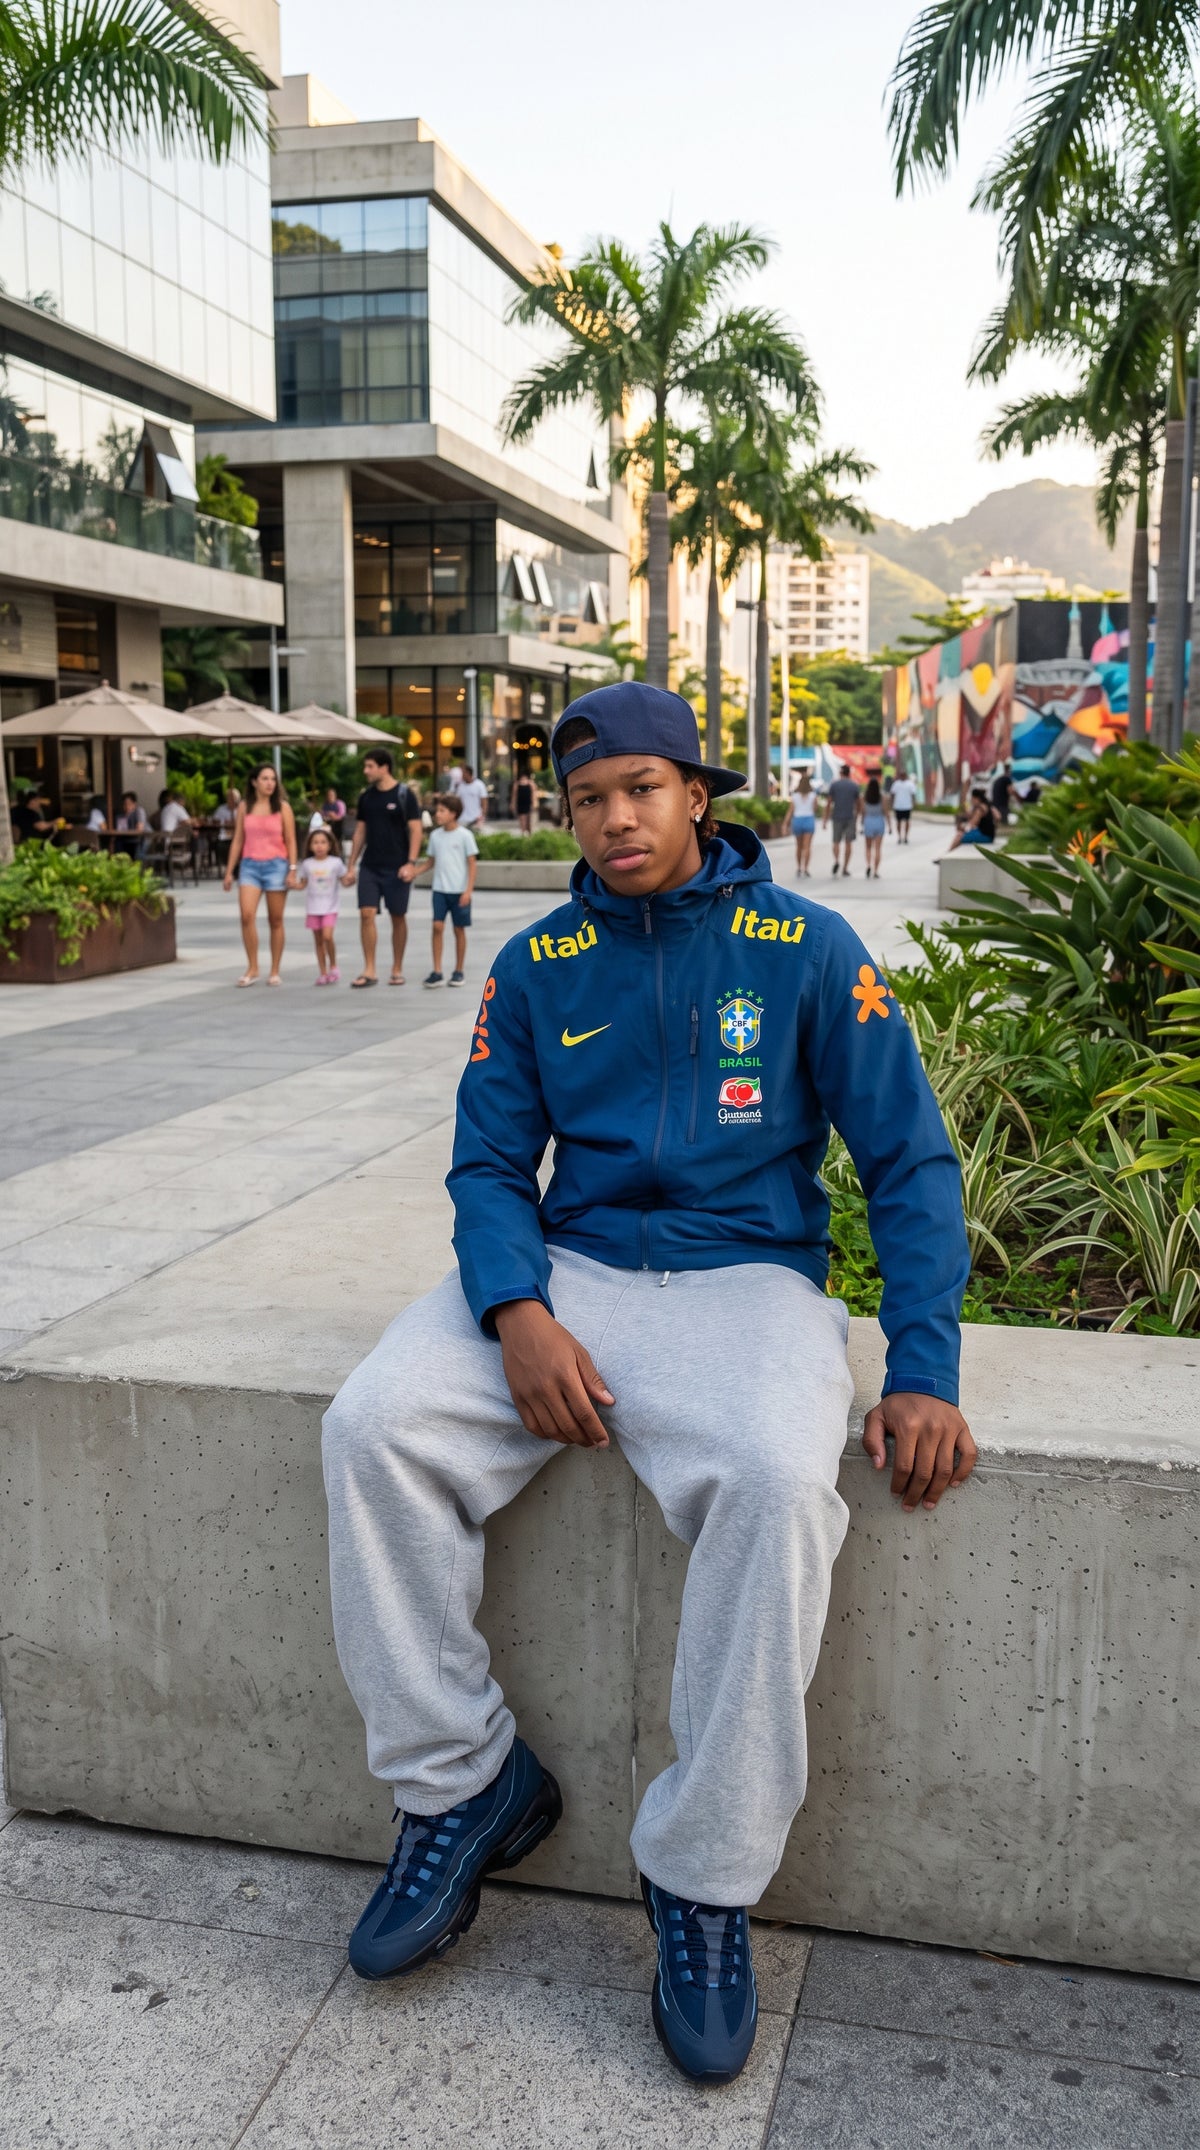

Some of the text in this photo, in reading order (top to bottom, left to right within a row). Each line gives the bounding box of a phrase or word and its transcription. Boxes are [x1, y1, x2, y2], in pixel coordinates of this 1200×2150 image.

[529, 920, 598, 962] Itaú
[730, 906, 806, 944] Itaú
[471, 976, 496, 1062] vivo
[731, 1020, 748, 1028] CBF
[719, 1057, 763, 1068] BRASIL
